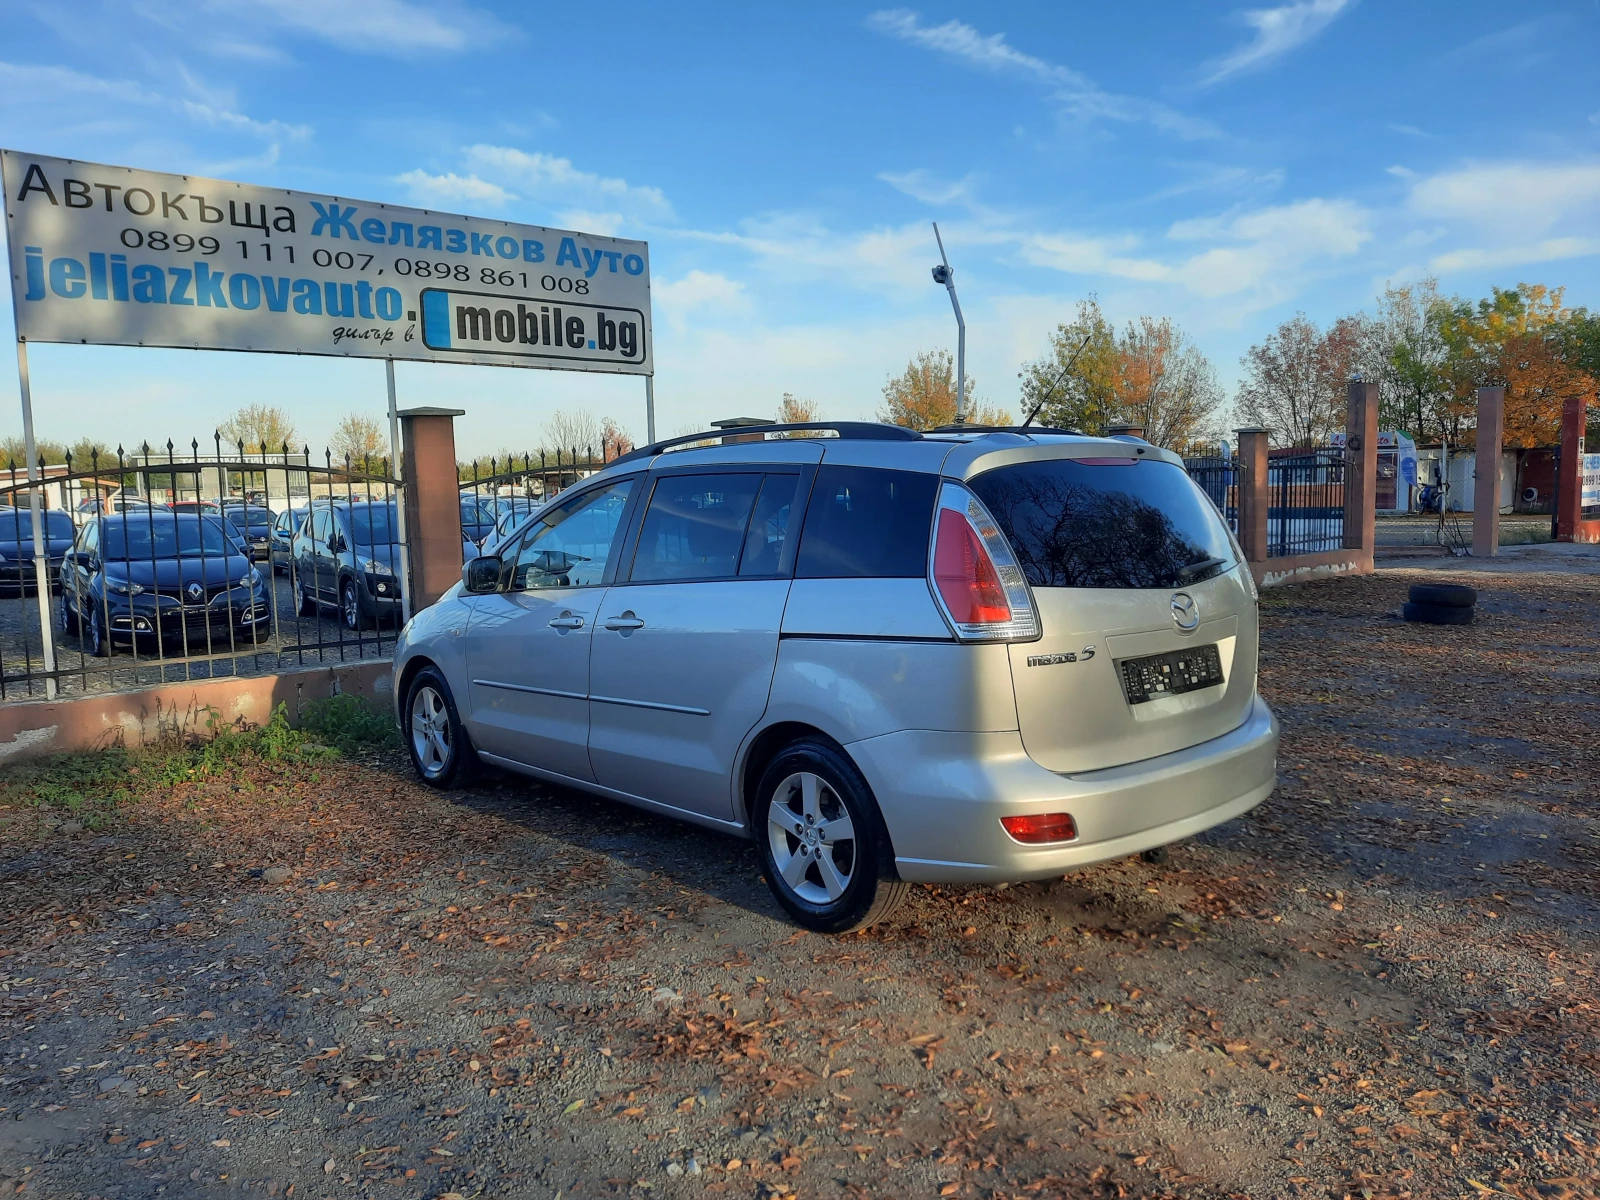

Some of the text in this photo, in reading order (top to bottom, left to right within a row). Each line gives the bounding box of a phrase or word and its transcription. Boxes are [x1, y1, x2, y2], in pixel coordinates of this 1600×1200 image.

[120, 228, 221, 255] 0899
[236, 240, 296, 264] 111
[394, 257, 471, 283] 0898
[480, 267, 529, 289] 861
[541, 274, 590, 296] 008
[308, 200, 546, 264] Желязков
[555, 236, 645, 279] Ауто
[455, 303, 638, 358] mobile.bg
[1027, 652, 1077, 668] mazda
